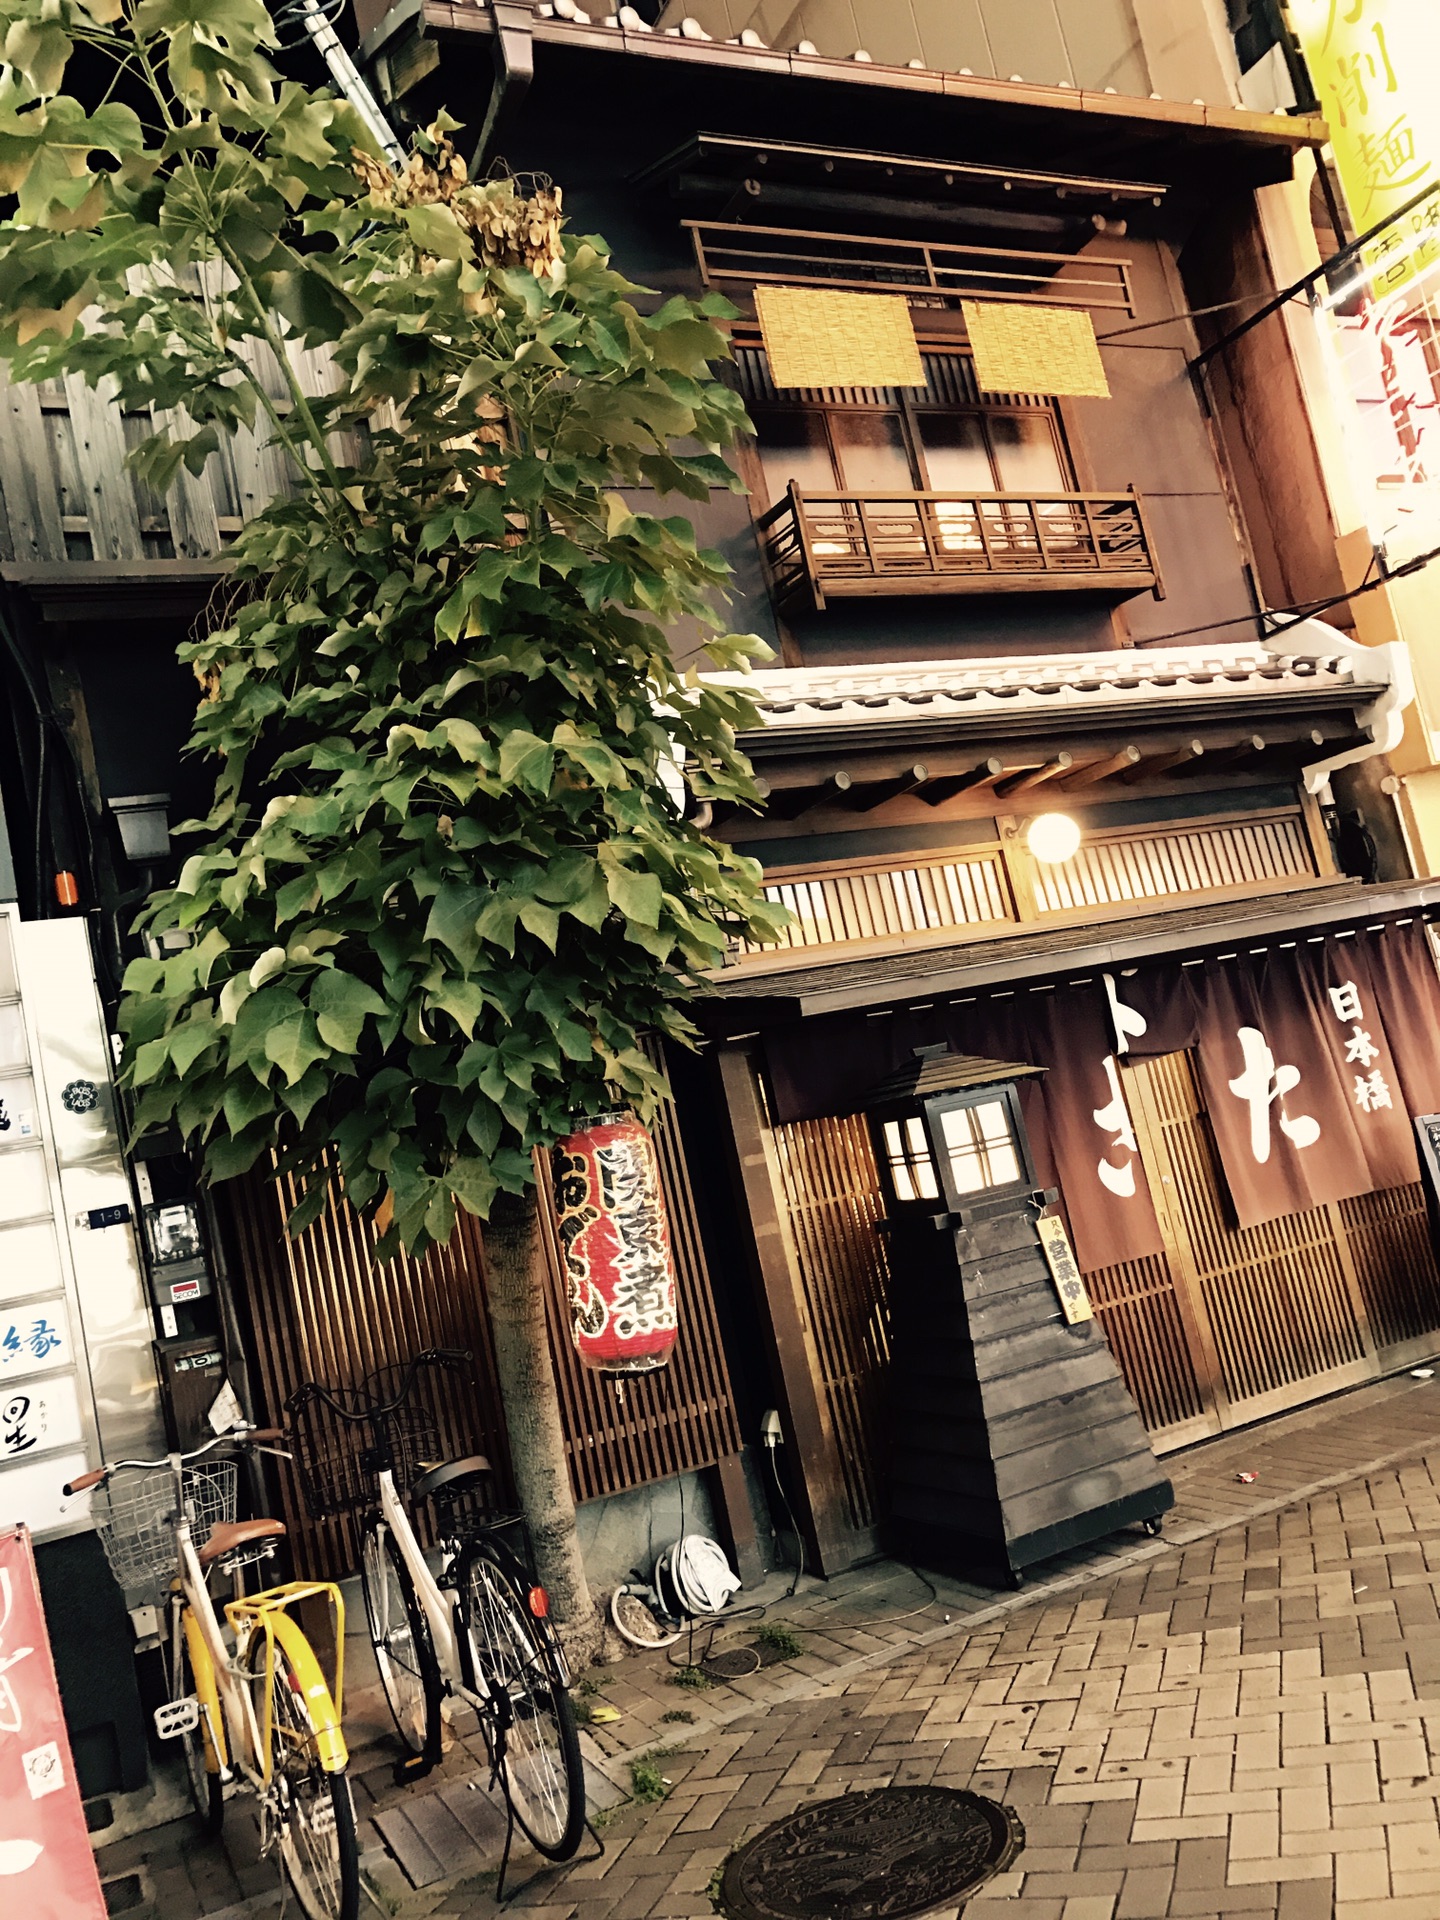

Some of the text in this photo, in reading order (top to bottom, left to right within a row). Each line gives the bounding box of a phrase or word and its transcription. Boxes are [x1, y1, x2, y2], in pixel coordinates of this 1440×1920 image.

[1328, 980, 1393, 1113] 日本橋
[100, 1209, 121, 1222] 1-9
[173, 1289, 199, 1300] SECOM
